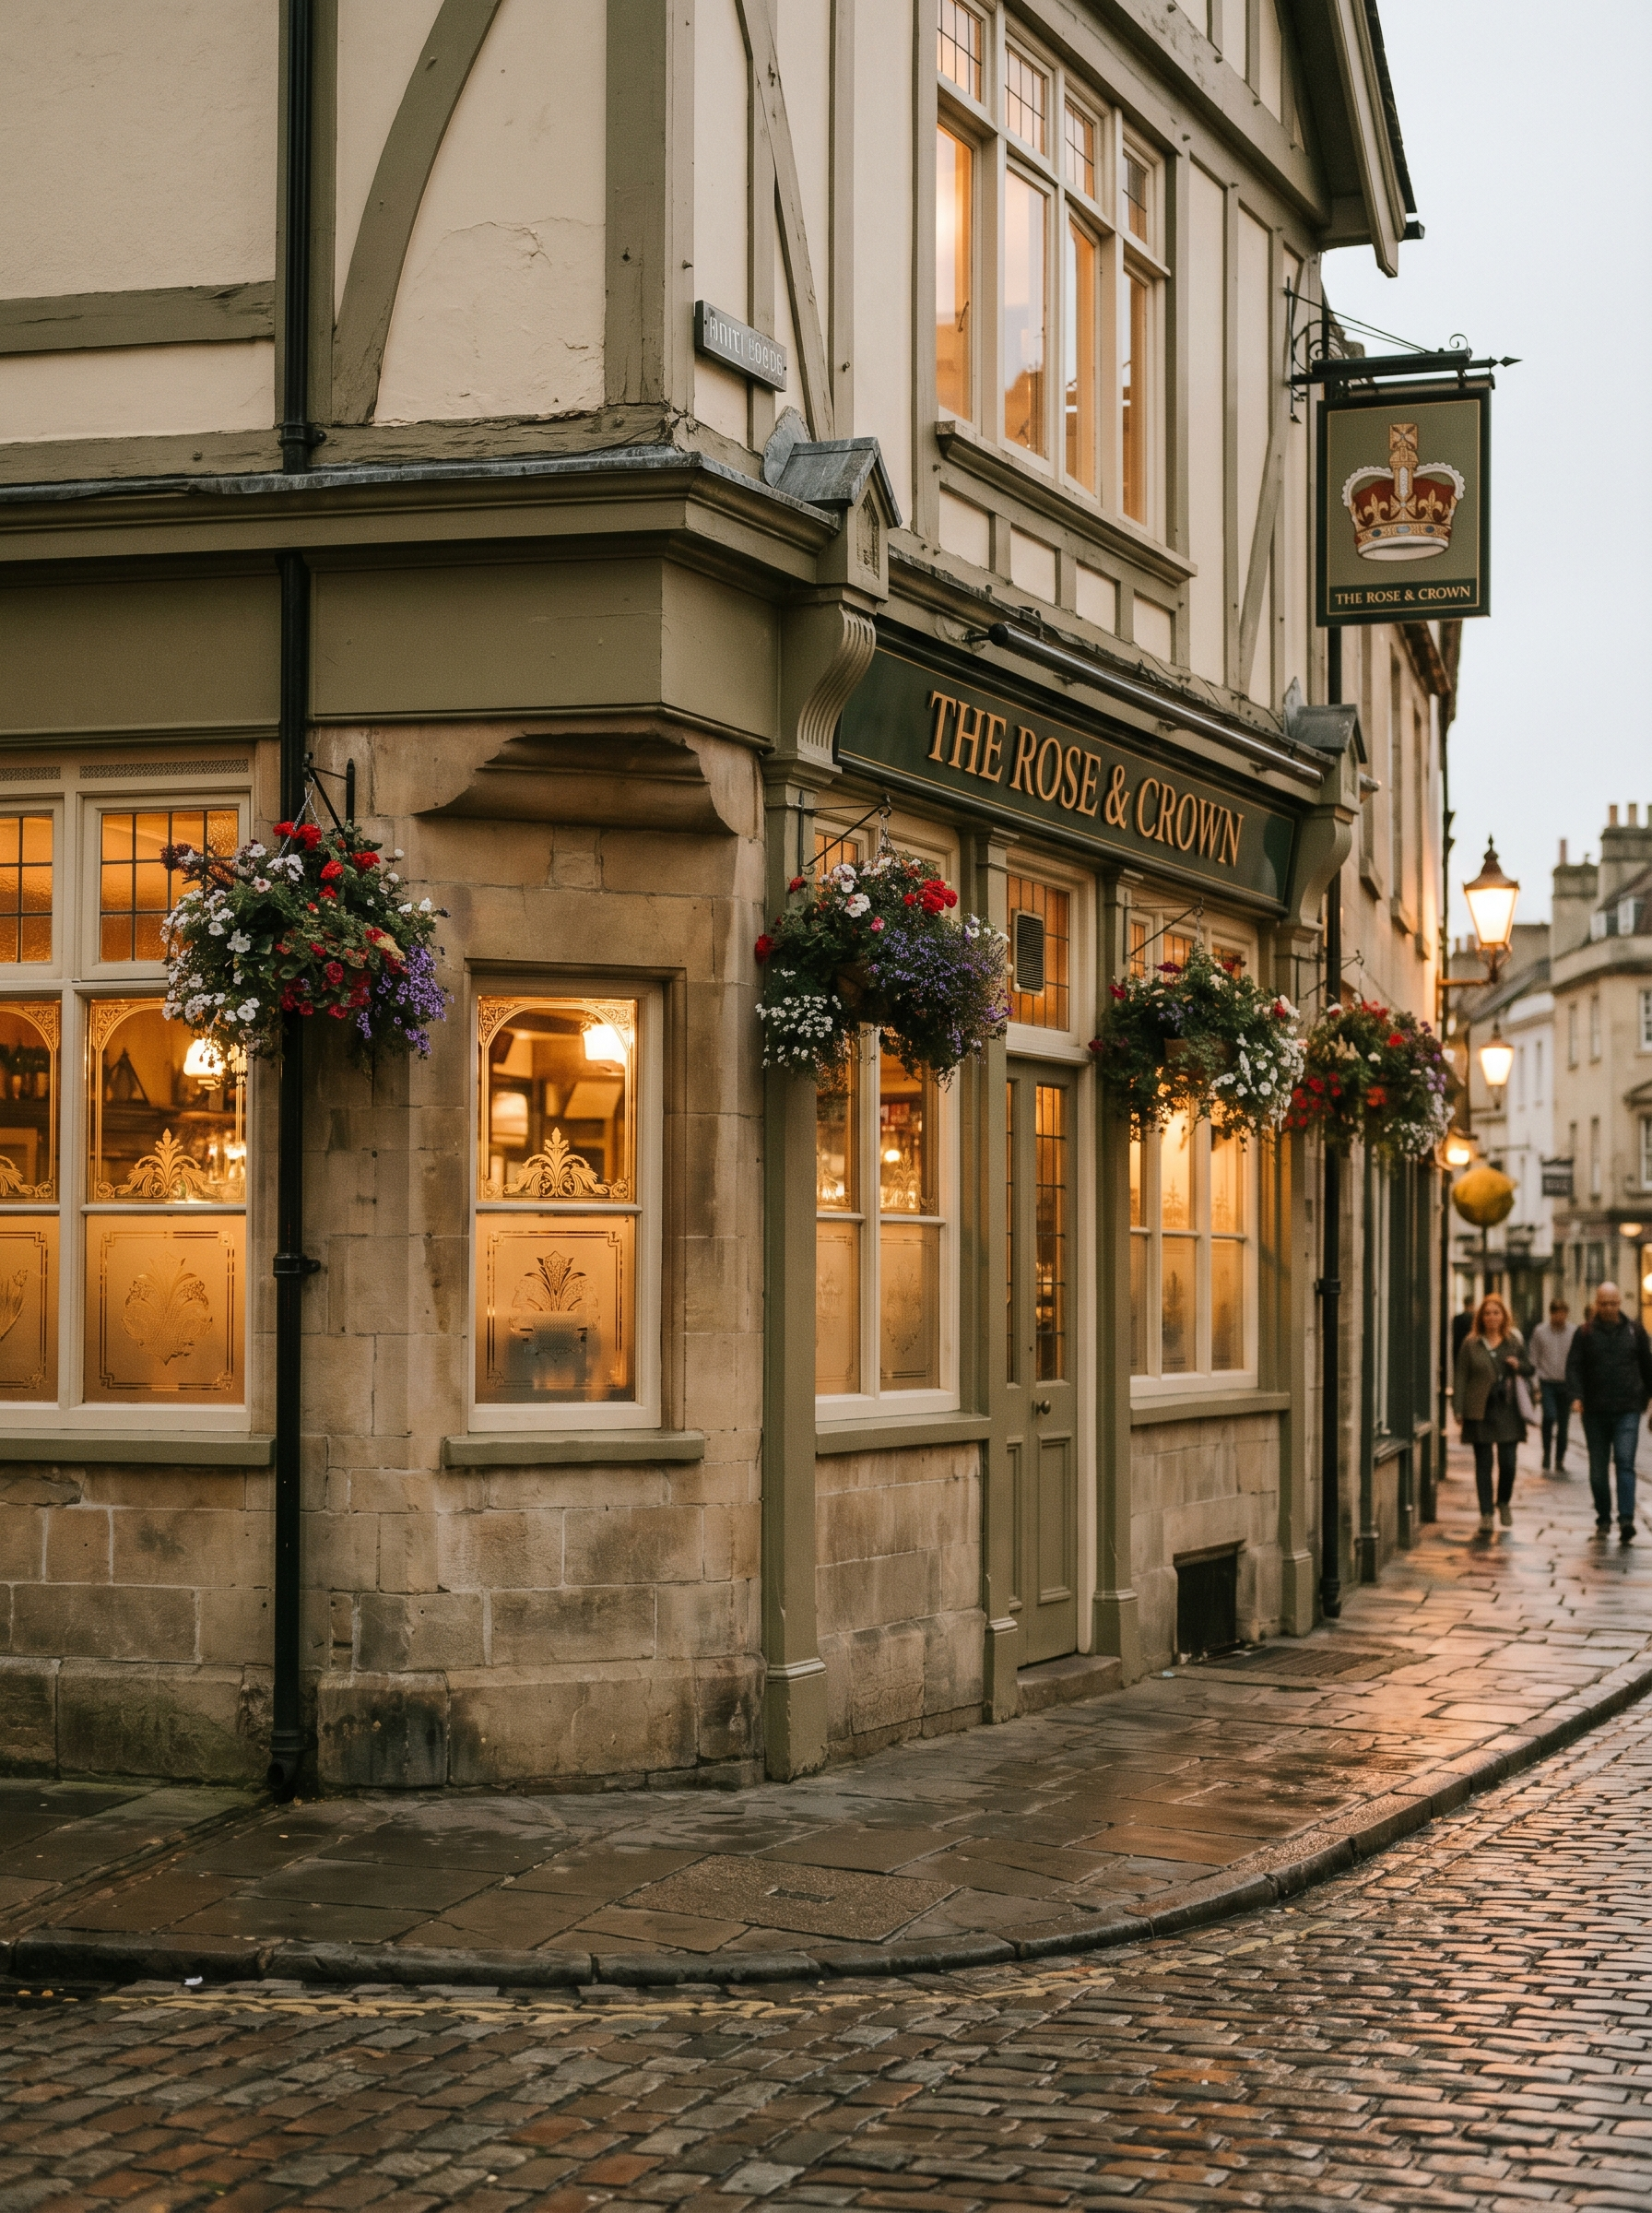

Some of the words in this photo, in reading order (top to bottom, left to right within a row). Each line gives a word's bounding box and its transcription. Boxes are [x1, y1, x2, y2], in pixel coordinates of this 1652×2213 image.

[1335, 593, 1362, 604] THE
[1366, 590, 1400, 602] ROSE
[1404, 589, 1415, 600] &
[1418, 586, 1470, 599] CROWN
[927, 690, 1008, 784] THE
[1009, 725, 1103, 818] ROSE
[1103, 763, 1131, 831] &
[1136, 776, 1245, 868] CROWN
